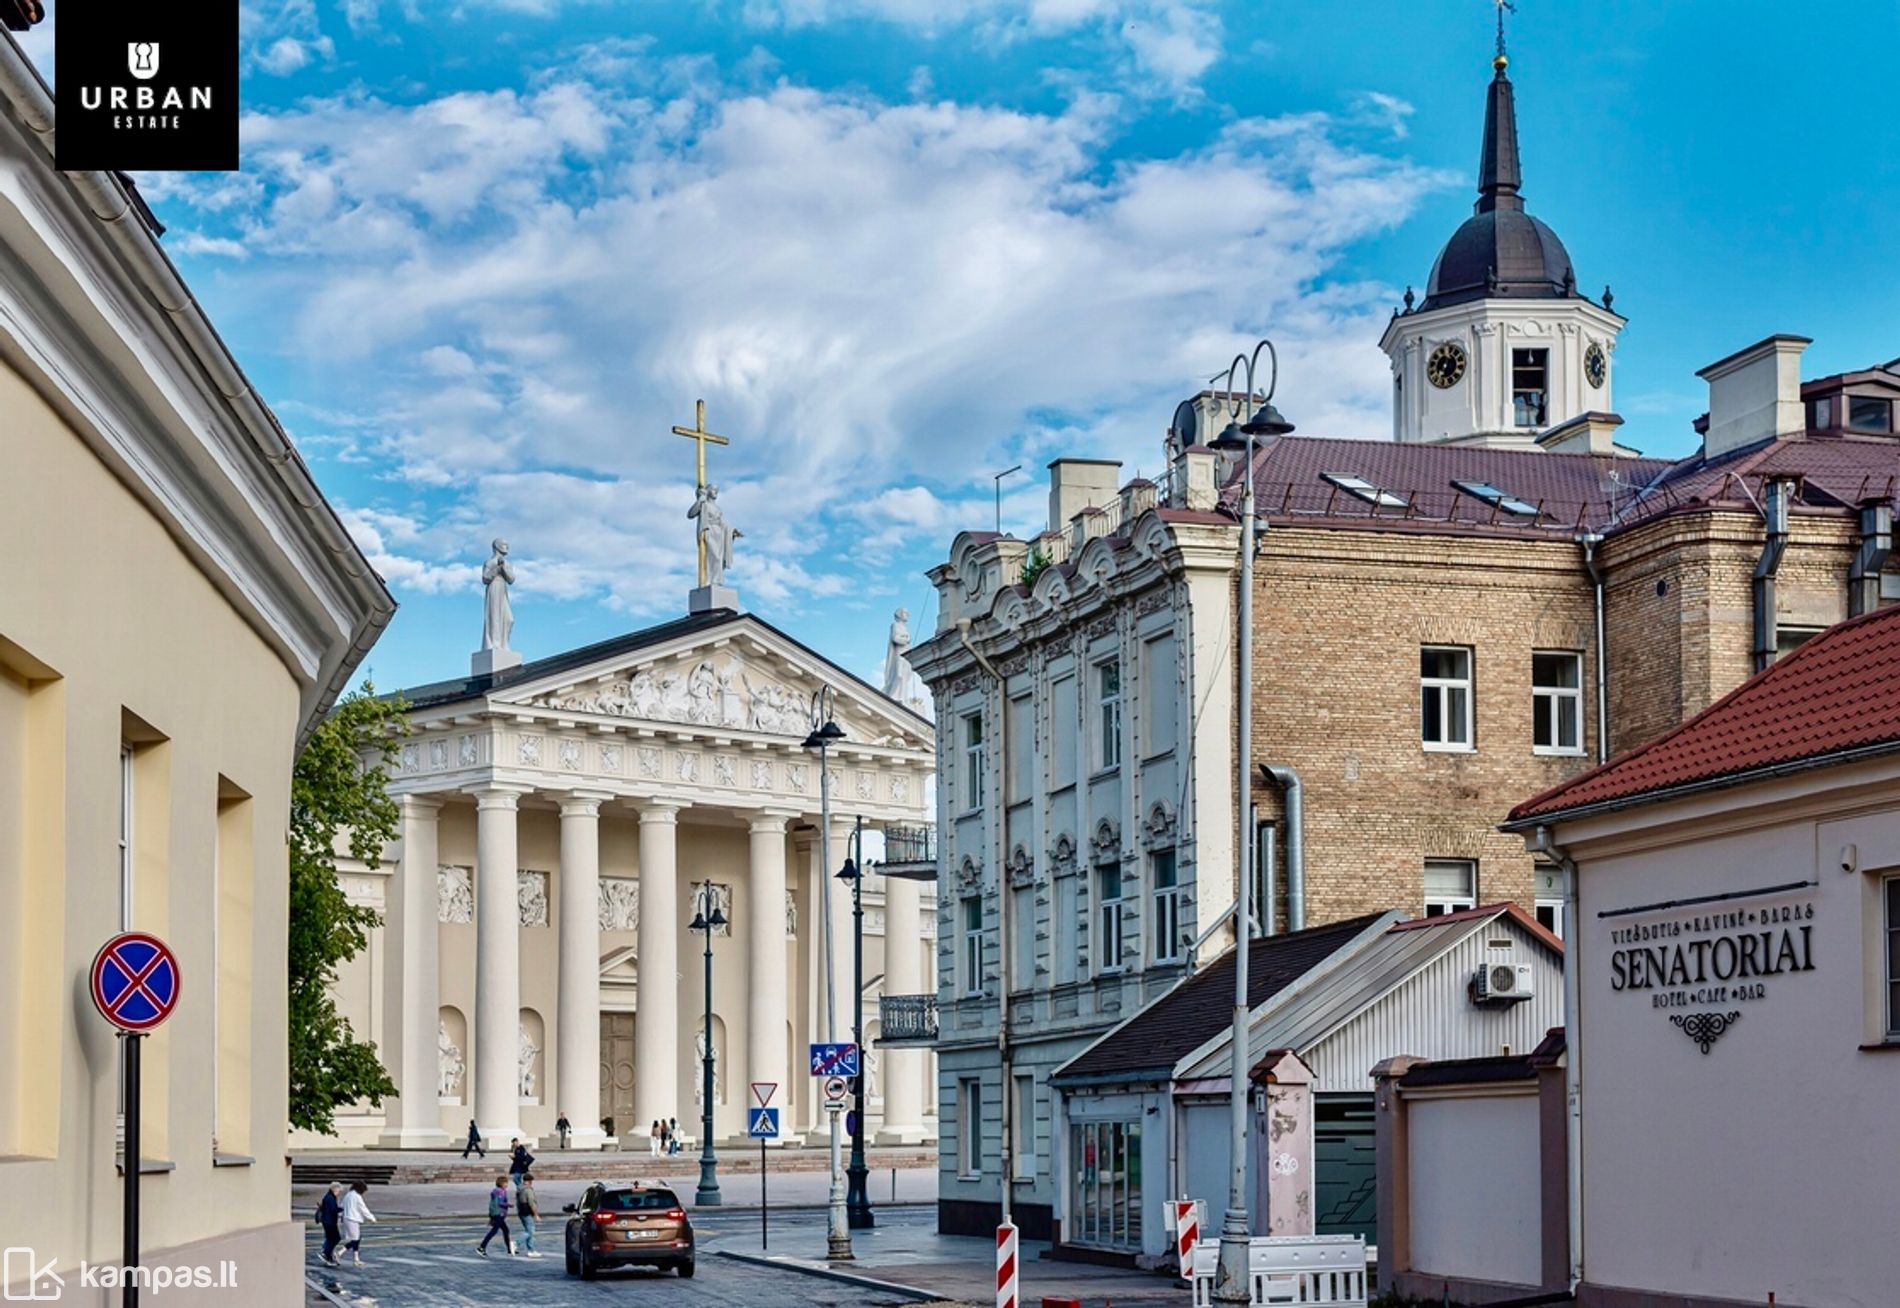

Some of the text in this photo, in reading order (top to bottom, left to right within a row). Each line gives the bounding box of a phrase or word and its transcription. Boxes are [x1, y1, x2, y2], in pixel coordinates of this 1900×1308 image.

[1760, 903, 1814, 925] BARAS
[1610, 925, 1816, 991] SENATORIAI
[1652, 991, 1687, 1008] HOTEL
[1740, 983, 1765, 1000] BAR
